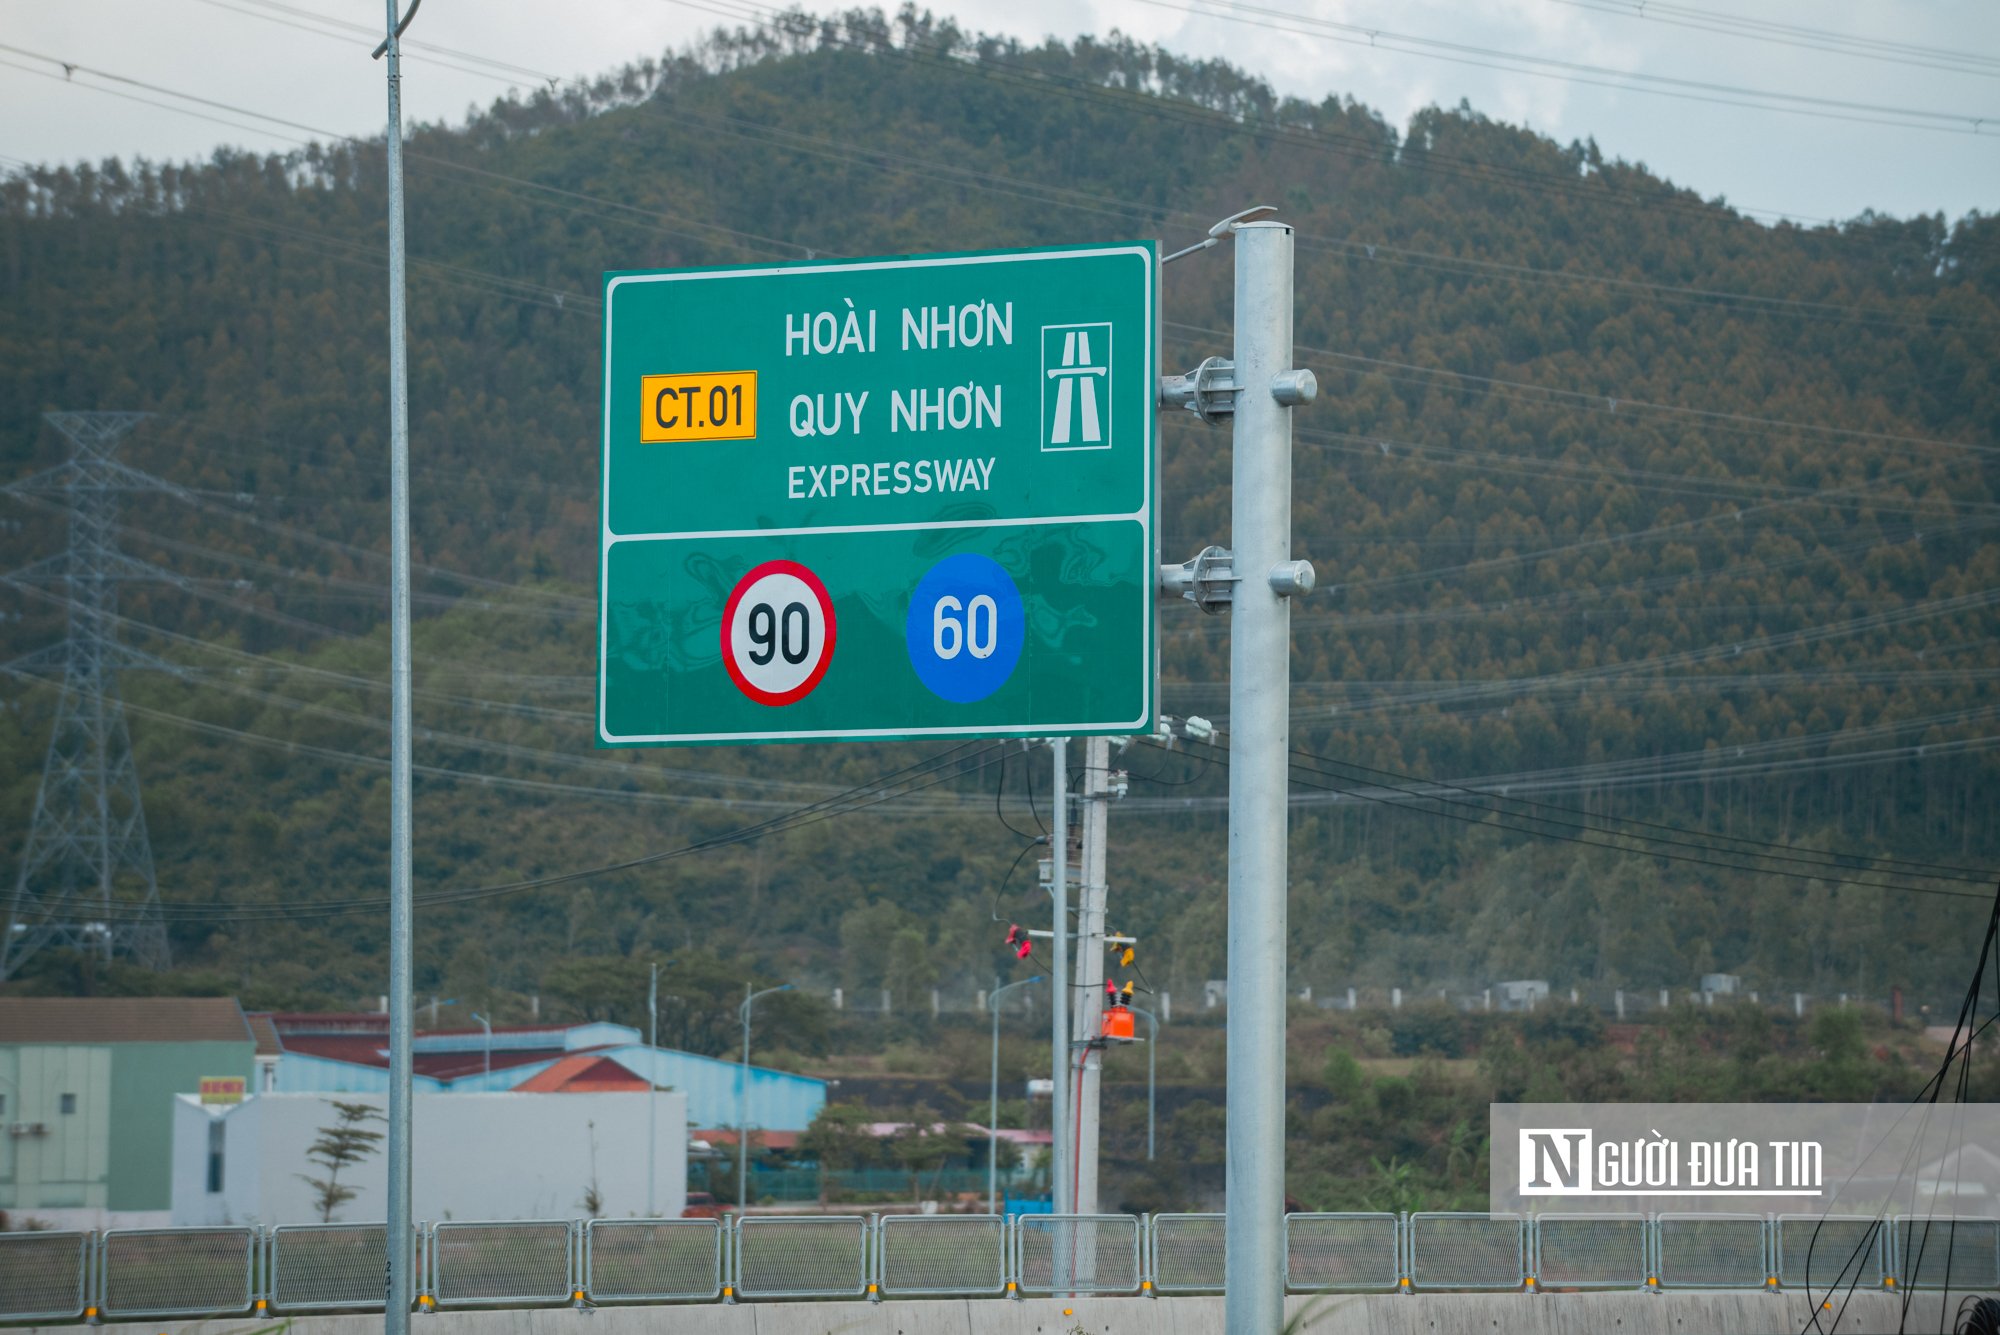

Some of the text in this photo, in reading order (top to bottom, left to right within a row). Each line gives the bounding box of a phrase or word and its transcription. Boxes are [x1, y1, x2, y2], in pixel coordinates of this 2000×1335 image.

[786, 298, 1013, 356] HOÀI NHƠN
[656, 385, 743, 428] CT.01
[790, 381, 1001, 437] QUY NHƠN
[789, 458, 995, 498] EXPRESSWAY
[748, 602, 810, 665] 90
[933, 595, 998, 659] 60
